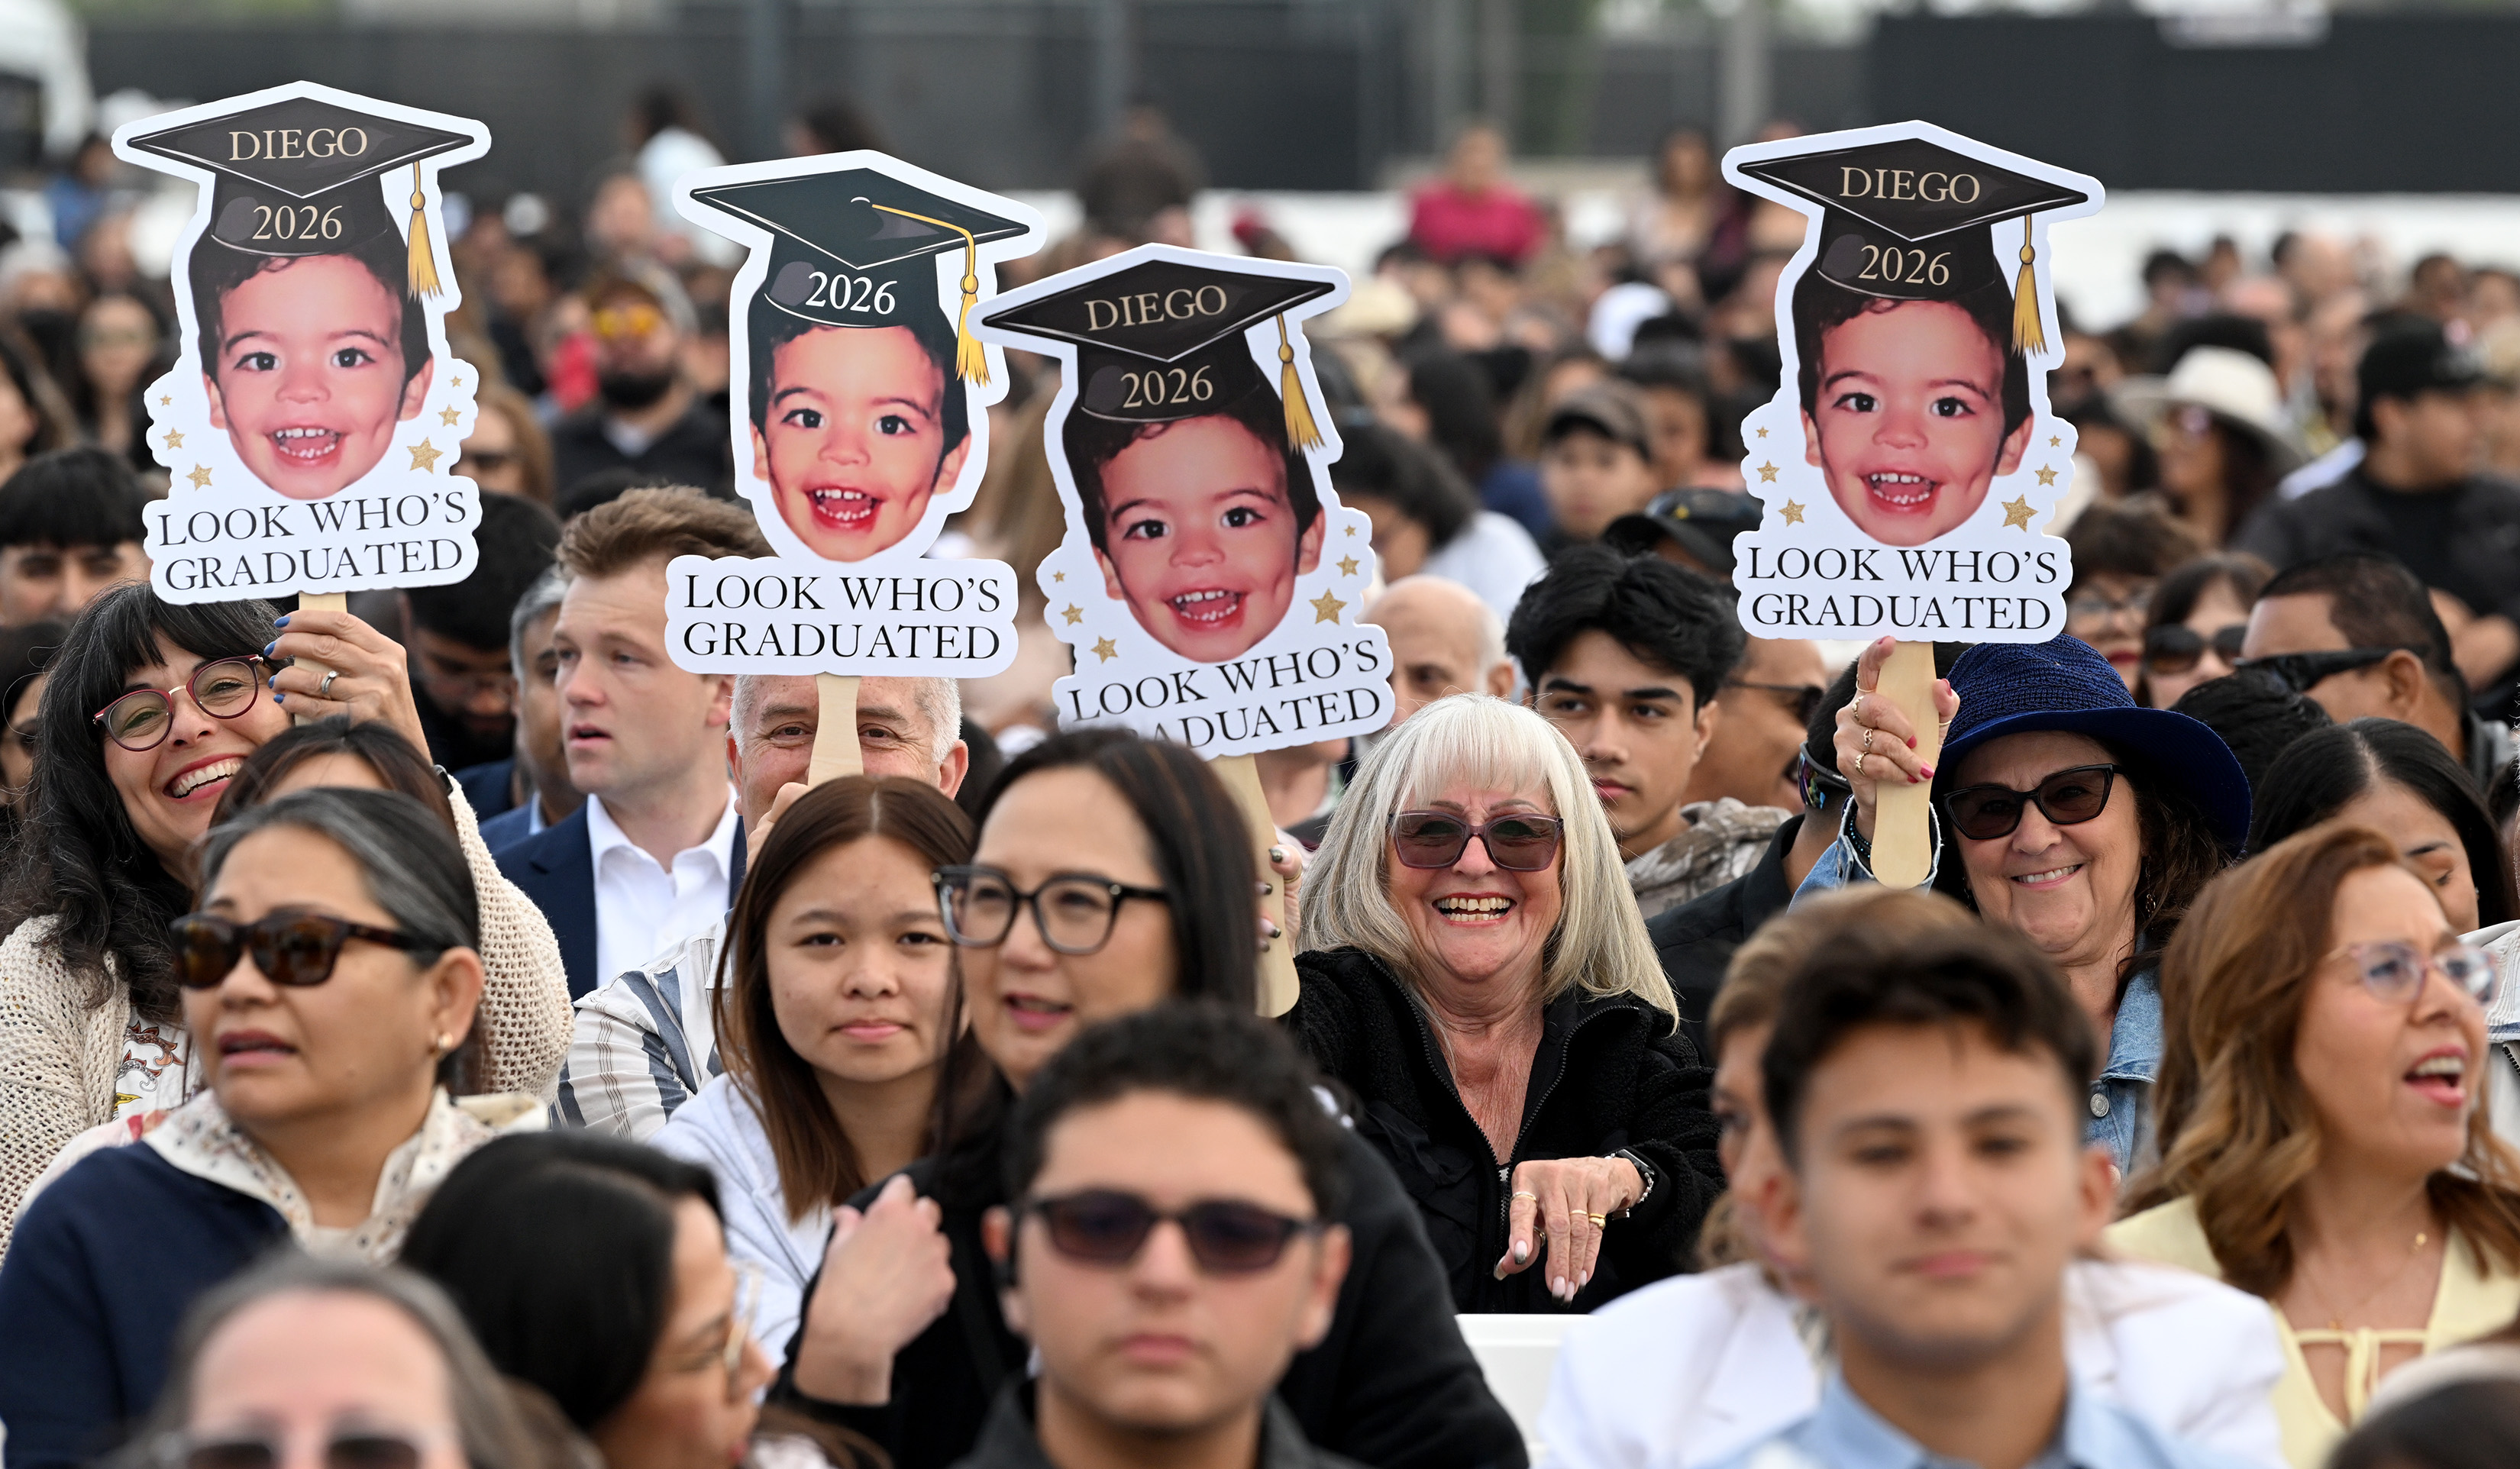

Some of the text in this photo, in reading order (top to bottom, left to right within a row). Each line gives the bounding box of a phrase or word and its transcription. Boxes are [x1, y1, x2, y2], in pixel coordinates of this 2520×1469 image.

[228, 128, 368, 161] DIEGO
[1840, 166, 1980, 205] DIEGO
[252, 205, 343, 241] 2026
[1859, 244, 1951, 285] 2026
[805, 271, 897, 315] 2026
[1084, 286, 1228, 331] DIEGO
[1120, 366, 1214, 408] 2026
[158, 492, 467, 546] LOOK WHO'S
[166, 539, 463, 589] GRADUATED
[1747, 547, 2057, 584] LOOK WHO'S
[684, 574, 1000, 612] LOOK WHO'S
[1753, 593, 2050, 630] GRADUATED
[683, 622, 1000, 659] GRADUATED
[1068, 640, 1378, 722] LOOK WHO'S
[1127, 686, 1381, 748] ADUATED
